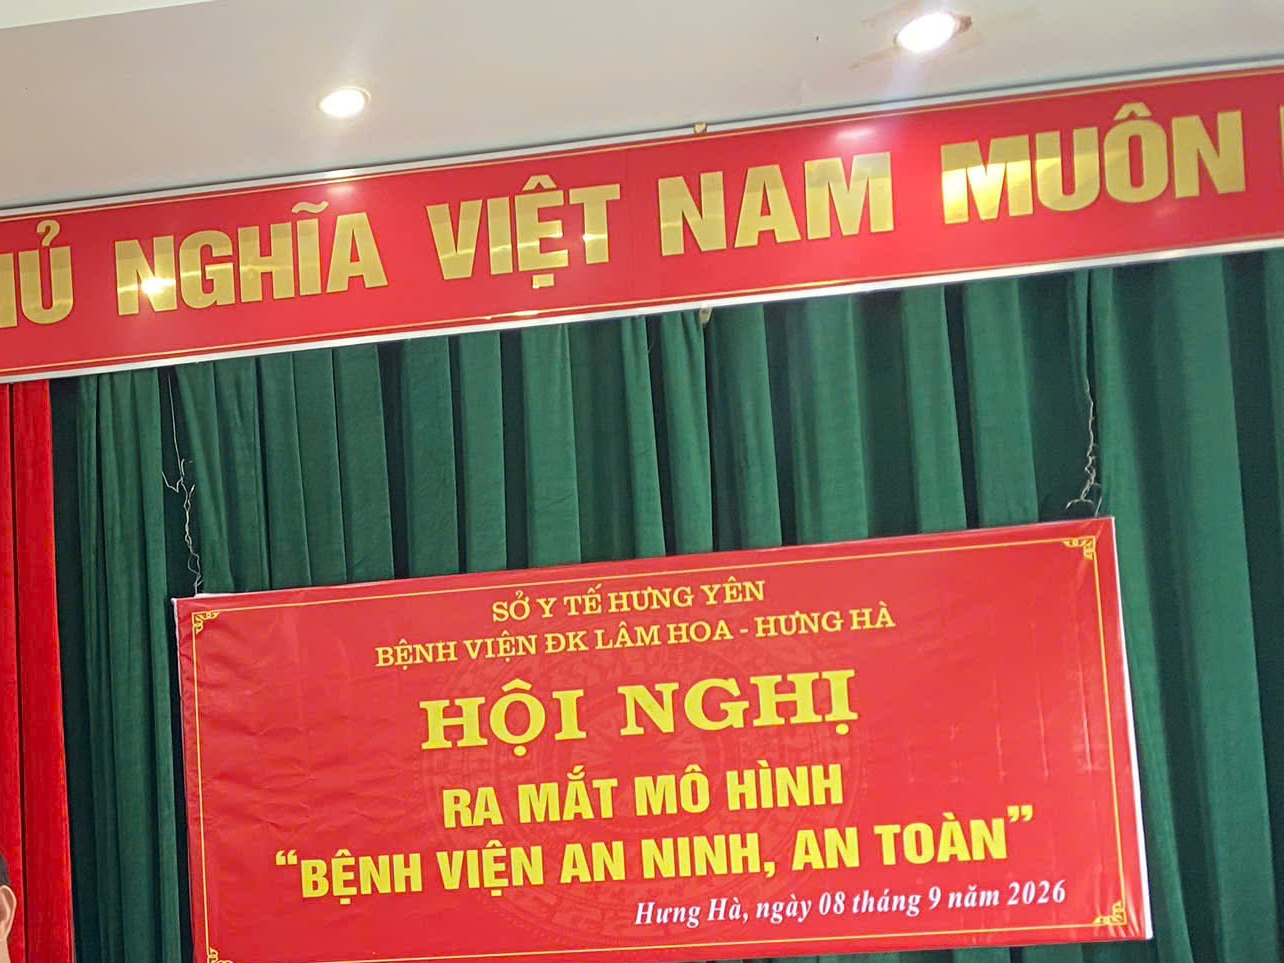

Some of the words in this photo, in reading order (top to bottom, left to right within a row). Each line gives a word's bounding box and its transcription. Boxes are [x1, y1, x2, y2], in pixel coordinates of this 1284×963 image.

[114, 200, 389, 317] NGHĨA
[426, 174, 621, 289] VIỆT
[658, 151, 895, 258] NAM
[939, 103, 1246, 225] MUÔN
[491, 590, 531, 623] SỞ
[536, 597, 557, 619] Y
[563, 584, 603, 617] TẾ
[607, 588, 693, 614] HƯNG
[699, 576, 766, 607] YÊN
[375, 638, 458, 671] BỆNH
[463, 631, 538, 665] VIỆN
[544, 630, 589, 655] ĐK
[595, 621, 662, 651] LÂM
[666, 620, 734, 645] HOA
[754, 610, 844, 639] HƯNG
[848, 600, 896, 631] HÀ
[419, 677, 587, 757] HỘI
[617, 669, 859, 736] NGHỊ
[442, 786, 504, 828] RA
[517, 765, 619, 823] MẮT
[634, 764, 711, 817] MÔ
[725, 760, 844, 811] HÌNH
[435, 839, 545, 897] VIỆN
[559, 840, 626, 884] AN
[640, 832, 776, 879] NINH,
[791, 826, 860, 871] AN
[633, 900, 701, 930] Hưng
[707, 896, 750, 925] Hà,
[755, 896, 813, 924] ngày
[818, 891, 846, 916] 08
[851, 887, 922, 919] tháng
[927, 886, 942, 911] 9
[947, 884, 1001, 909] năm
[1007, 879, 1067, 906] 2026
